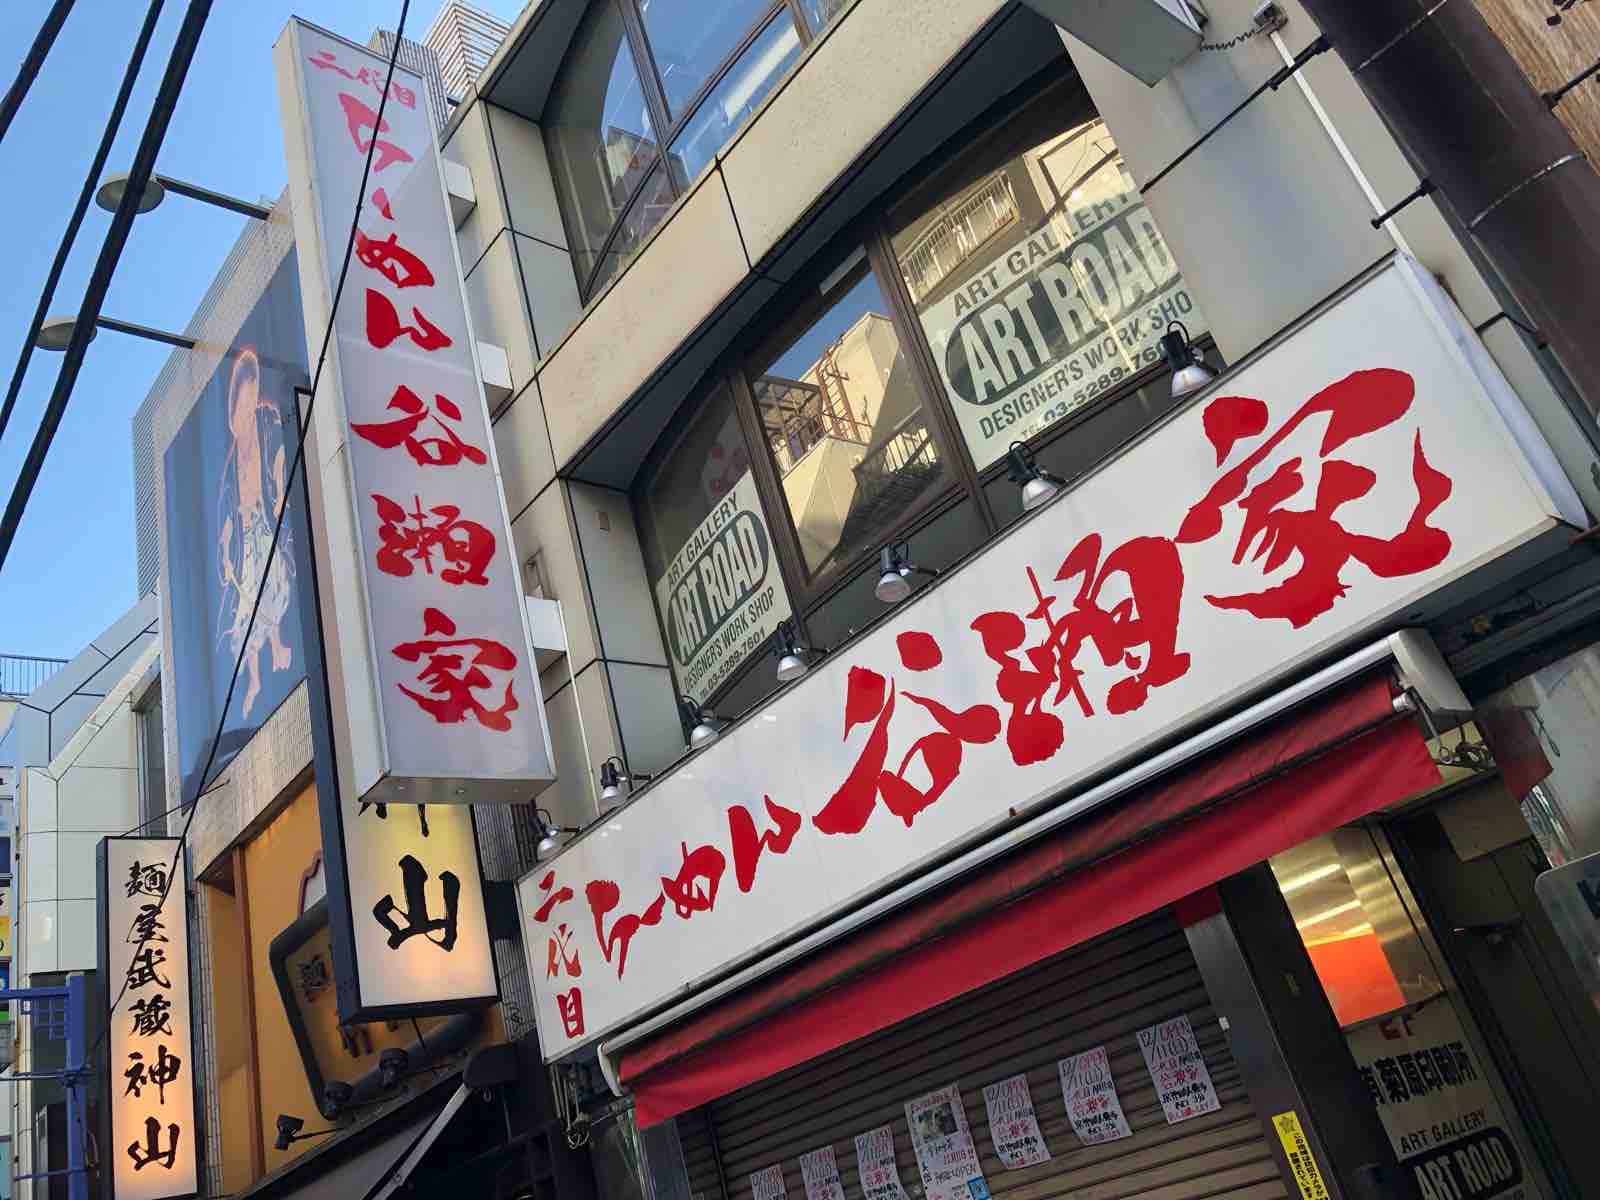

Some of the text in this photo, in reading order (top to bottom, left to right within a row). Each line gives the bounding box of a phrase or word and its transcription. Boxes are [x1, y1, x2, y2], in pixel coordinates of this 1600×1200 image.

[304, 50, 417, 110] 二代目
[952, 267, 1000, 318] ART
[959, 206, 1179, 403] ART ROAD
[978, 358, 1084, 440] DESIGNER'S
[1083, 318, 1147, 369] WORK
[667, 491, 738, 593] ART GALLERY
[671, 514, 764, 664] ART ROAD
[720, 611, 749, 650] WORK
[748, 585, 775, 623] SHOP
[533, 870, 585, 1038] 二代目
[1400, 1108, 1486, 1153] ART GALLERY
[1413, 1137, 1513, 1200] ART ROAD
